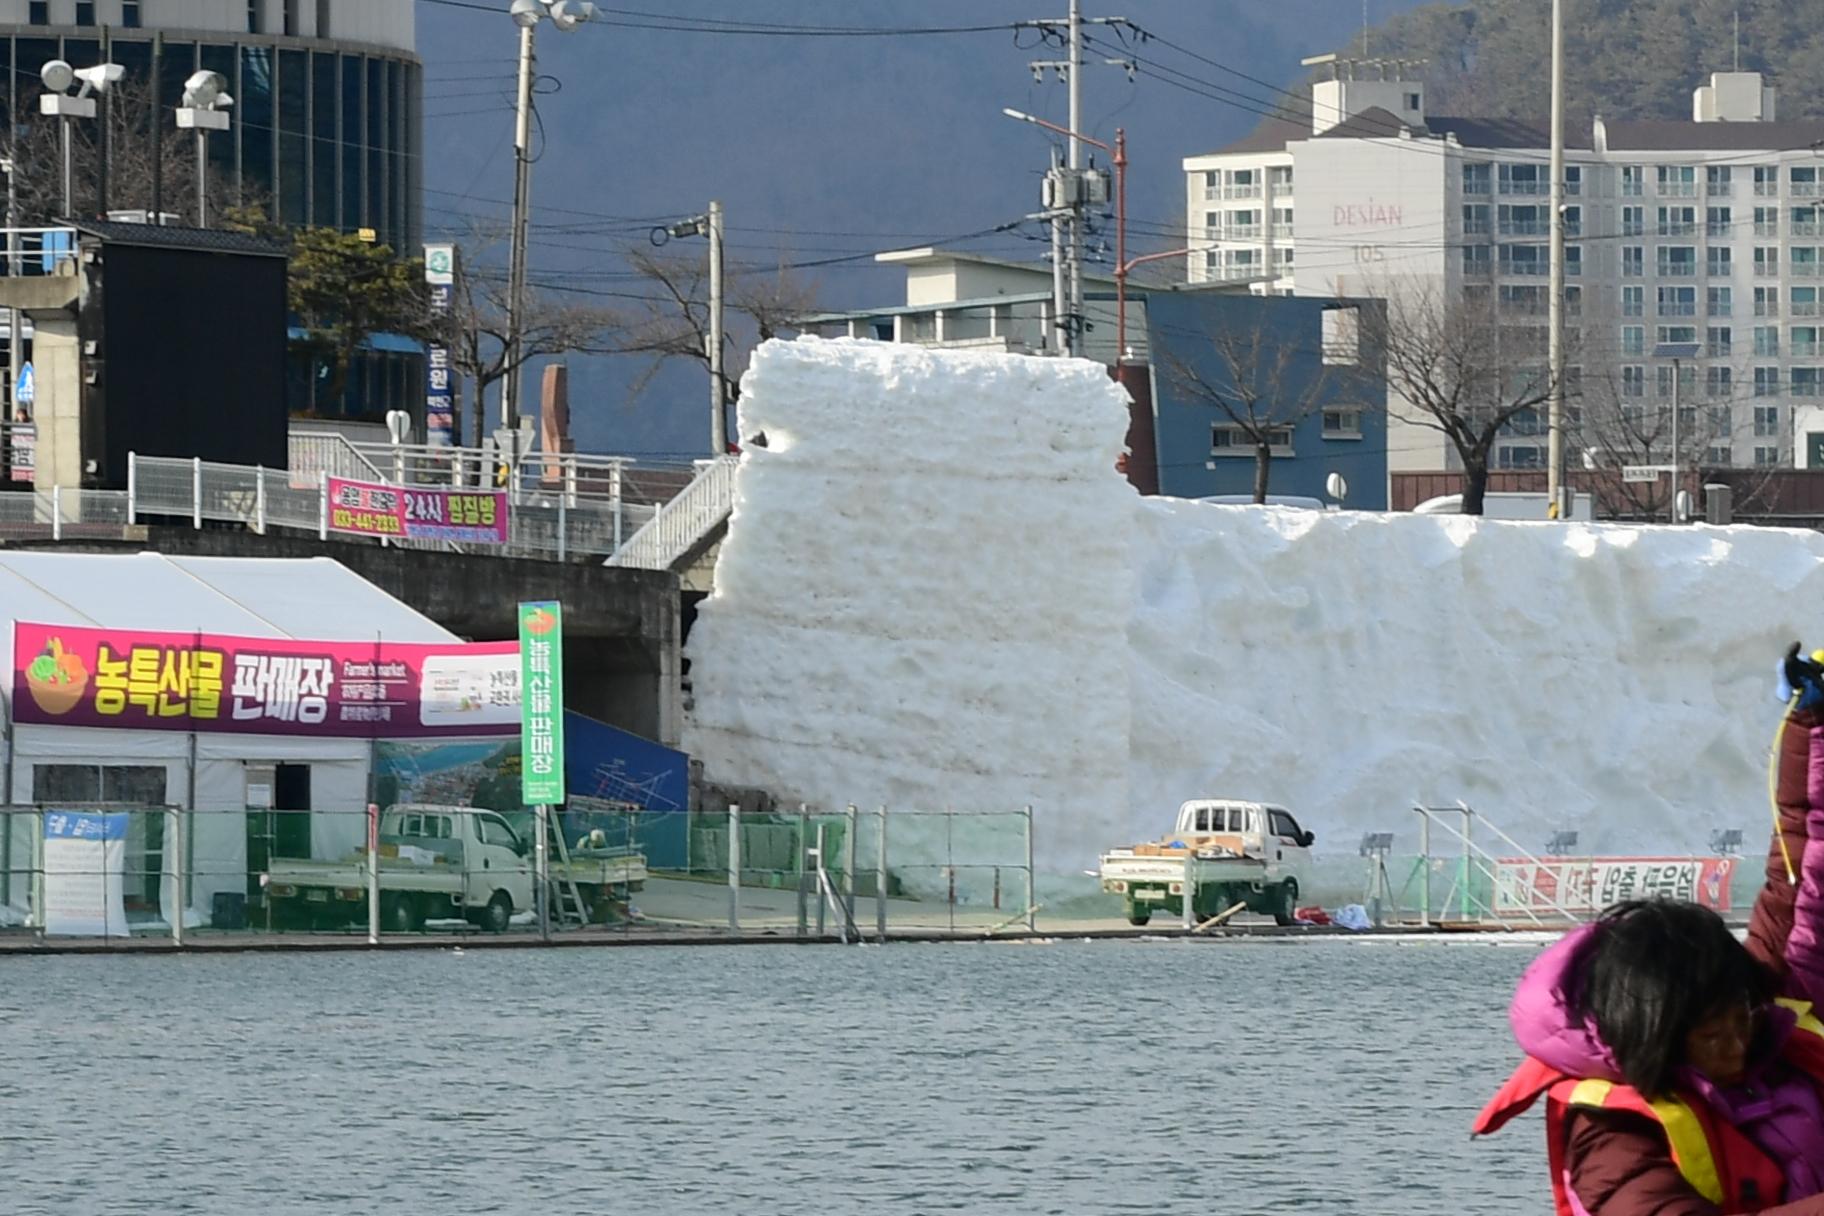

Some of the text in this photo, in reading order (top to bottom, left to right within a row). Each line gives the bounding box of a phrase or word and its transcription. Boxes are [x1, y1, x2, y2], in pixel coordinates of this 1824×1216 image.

[1352, 245, 1384, 264] 105
[404, 493, 442, 523] 24시
[95, 646, 334, 724] 농특산물 판매장
[528, 638, 553, 714] 농특산물
[529, 717, 555, 775] 판매장
